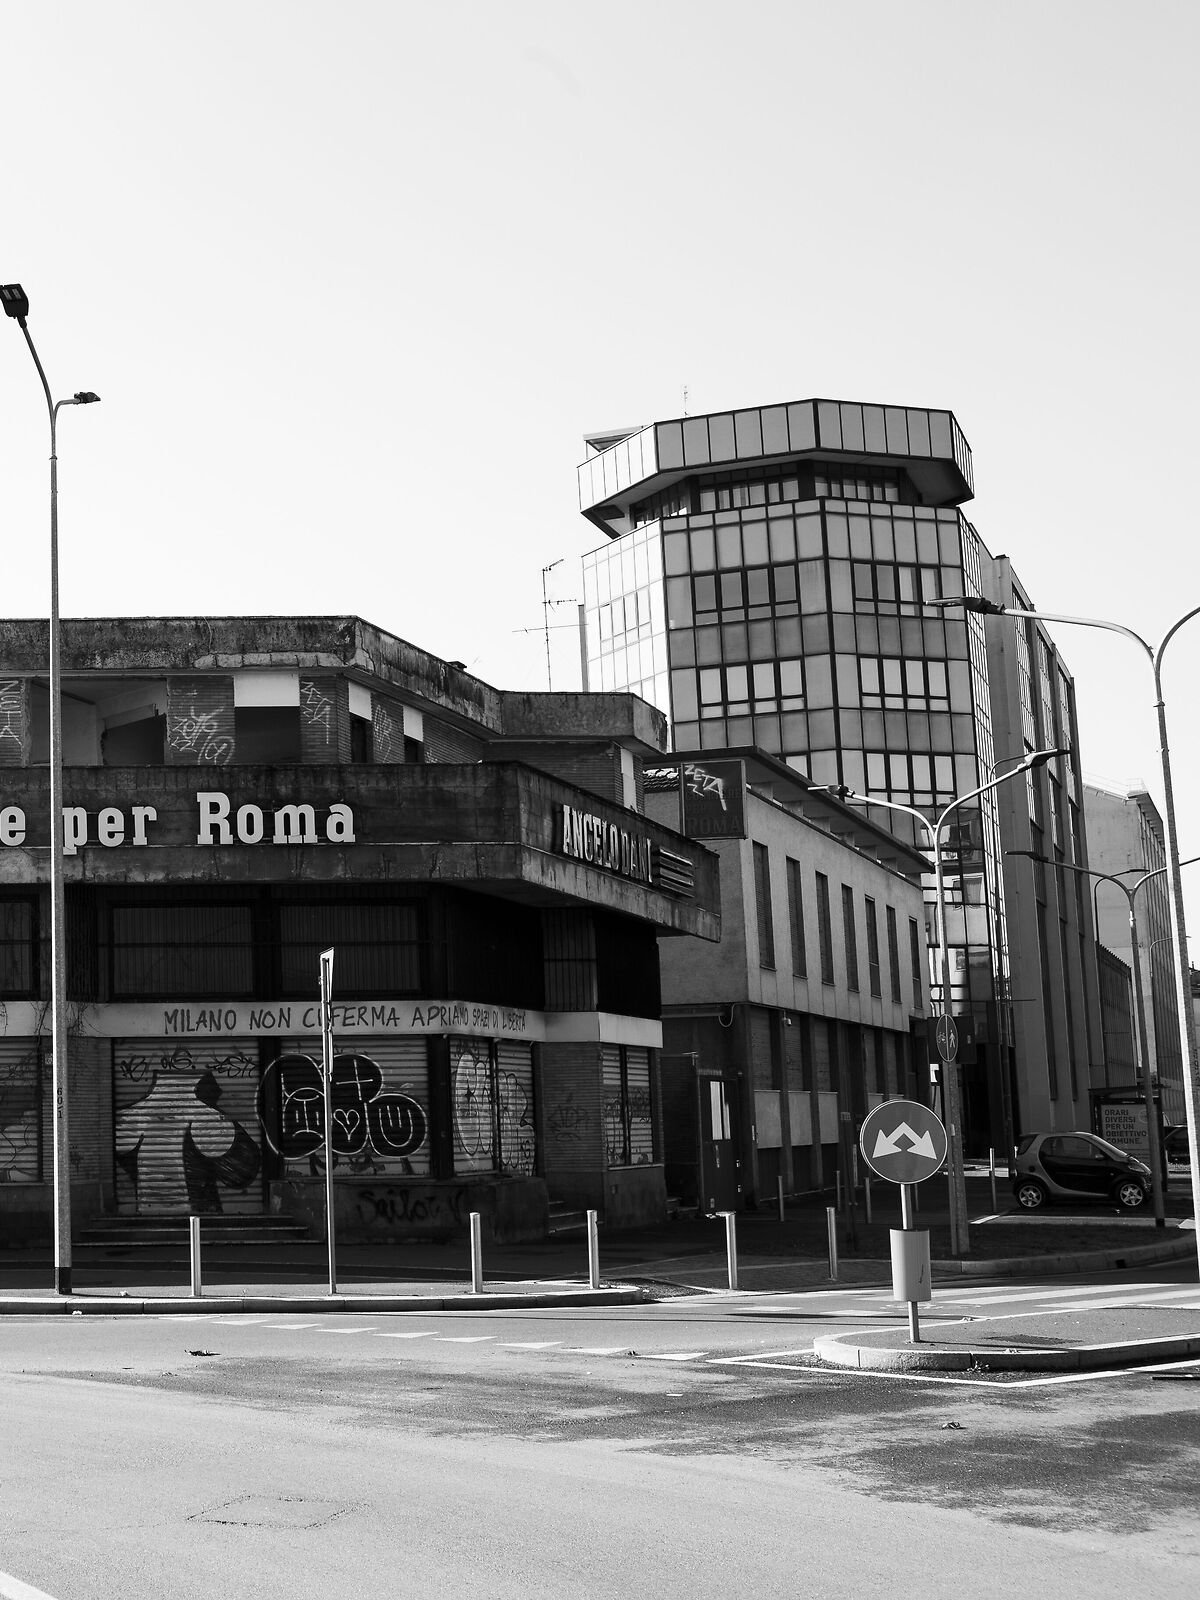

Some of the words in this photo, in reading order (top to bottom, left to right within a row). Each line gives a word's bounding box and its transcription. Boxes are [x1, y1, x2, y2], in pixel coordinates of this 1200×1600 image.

[62, 804, 157, 856] per
[197, 791, 356, 845] Roma
[562, 803, 619, 871] ANGELO
[620, 827, 653, 884] DANI
[164, 1006, 237, 1034] MILANO
[249, 1006, 291, 1030] NON
[331, 1004, 400, 1028] FERMA
[411, 1005, 469, 1028] APRIAMO
[472, 1007, 490, 1030] SPAZI
[493, 1010, 499, 1029] DI
